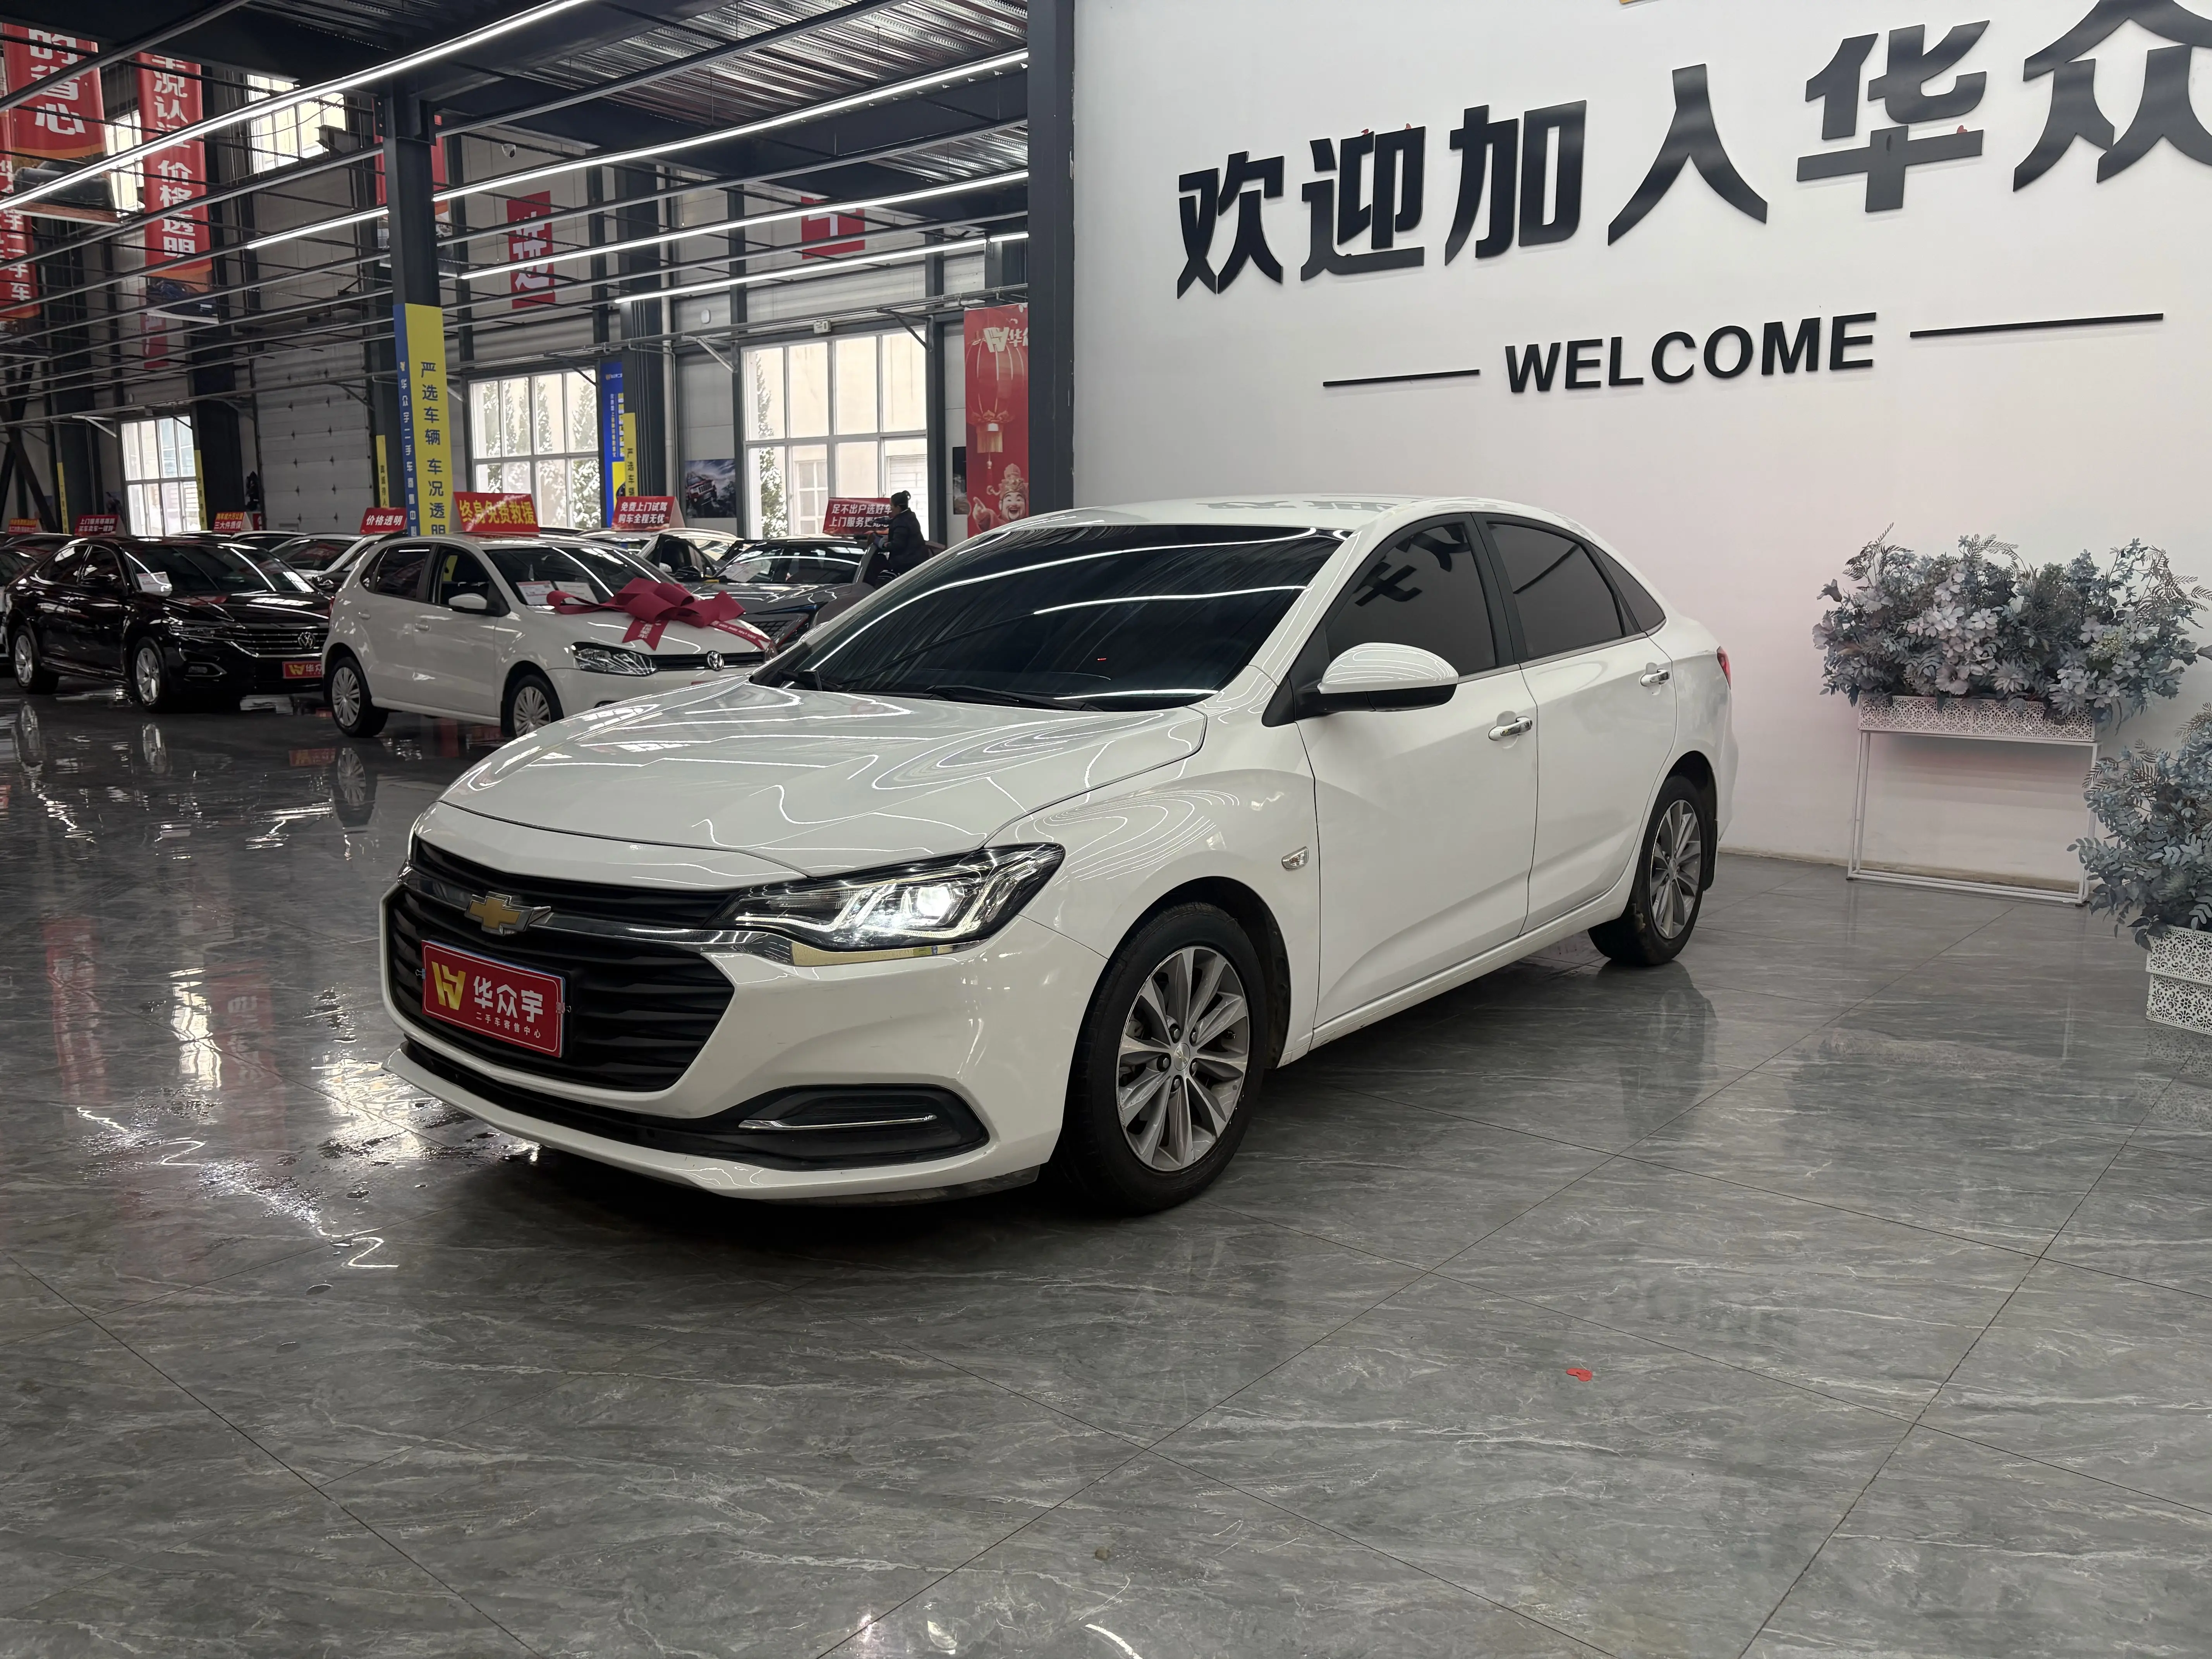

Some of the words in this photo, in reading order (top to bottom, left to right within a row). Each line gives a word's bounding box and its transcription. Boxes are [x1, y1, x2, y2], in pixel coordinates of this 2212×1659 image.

[1505, 313, 1877, 392] WELCOME
[421, 361, 441, 445] 严选车辆
[427, 458, 446, 535] 车况透明
[620, 502, 668, 512] 免费上门试驾
[366, 515, 403, 526] 价格透明
[459, 500, 536, 524] 终身免费救援
[618, 514, 665, 524] 购车全程无忧
[831, 504, 892, 515] 足不出户选好车
[473, 976, 543, 1023] 华众宇
[476, 1012, 541, 1039] 二手车寄售中心
